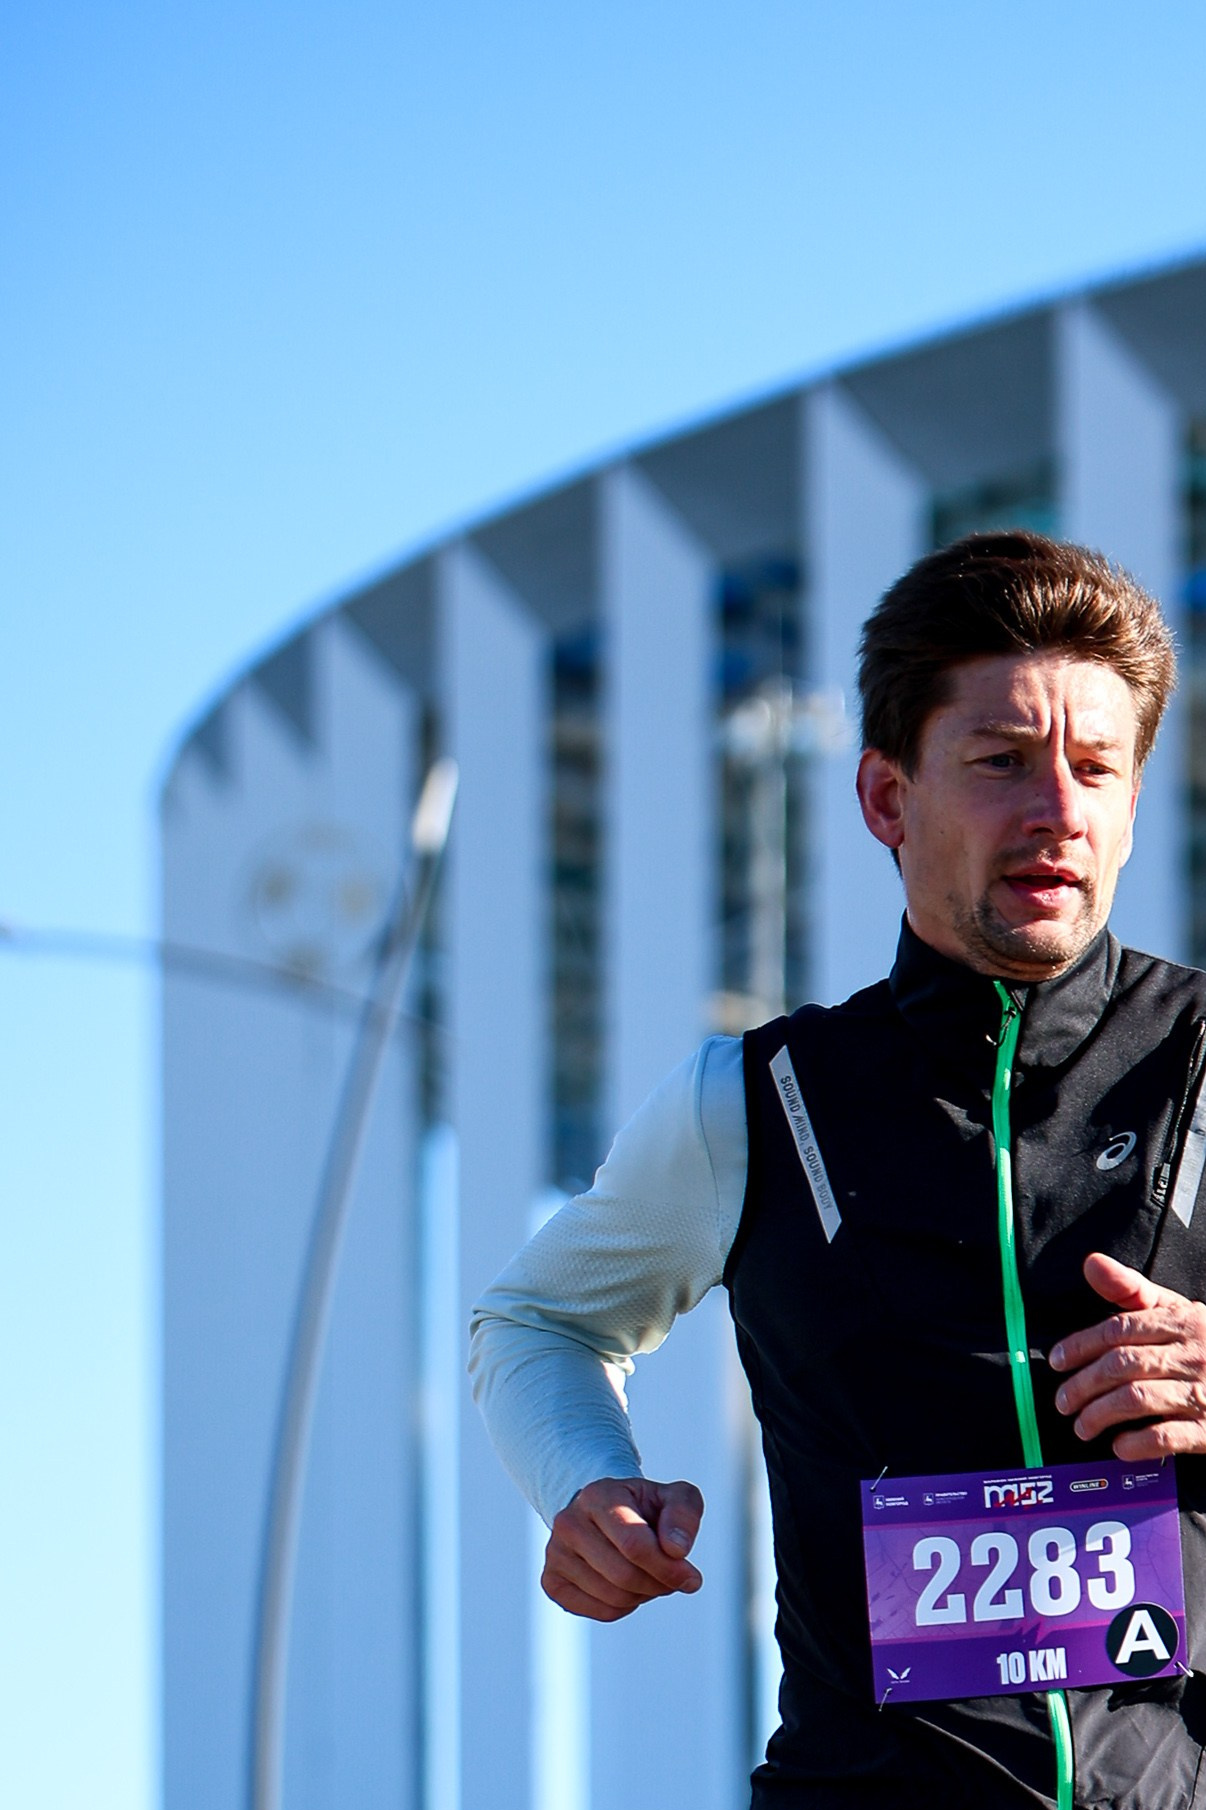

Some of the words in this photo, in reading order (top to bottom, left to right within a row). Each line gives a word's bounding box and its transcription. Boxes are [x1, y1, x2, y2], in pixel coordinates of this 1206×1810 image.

[780, 1074, 800, 1113] SOUND
[803, 1145, 824, 1183] SOUND
[817, 1183, 833, 1210] BODY
[913, 1521, 1136, 1626] 2283
[996, 1652, 1026, 1685] 10
[1029, 1647, 1068, 1682] KM
[1115, 1610, 1171, 1664] A
